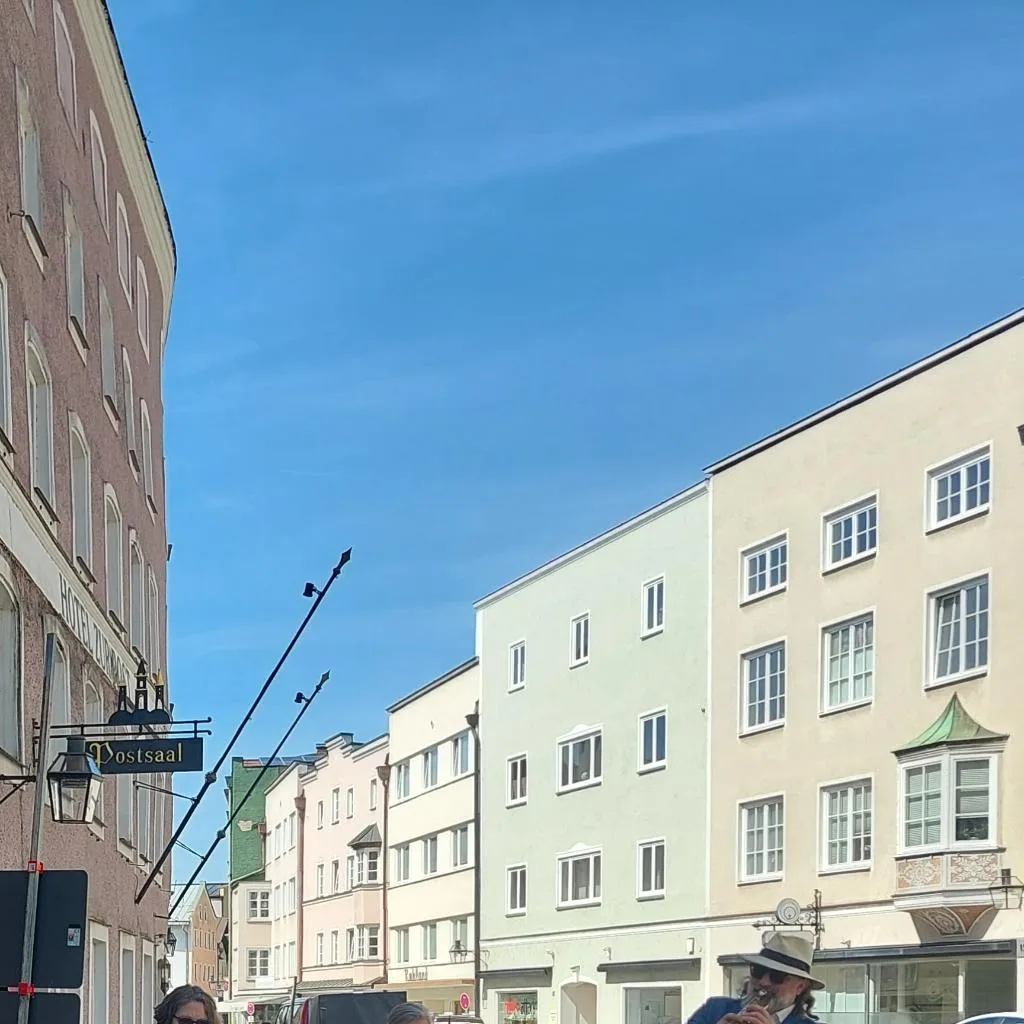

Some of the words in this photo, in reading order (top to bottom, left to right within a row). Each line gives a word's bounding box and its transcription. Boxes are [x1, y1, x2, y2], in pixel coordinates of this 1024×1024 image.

[59, 572, 93, 656] HOTEL
[93, 623, 112, 679] ZUR
[89, 741, 183, 768] Postsaal
